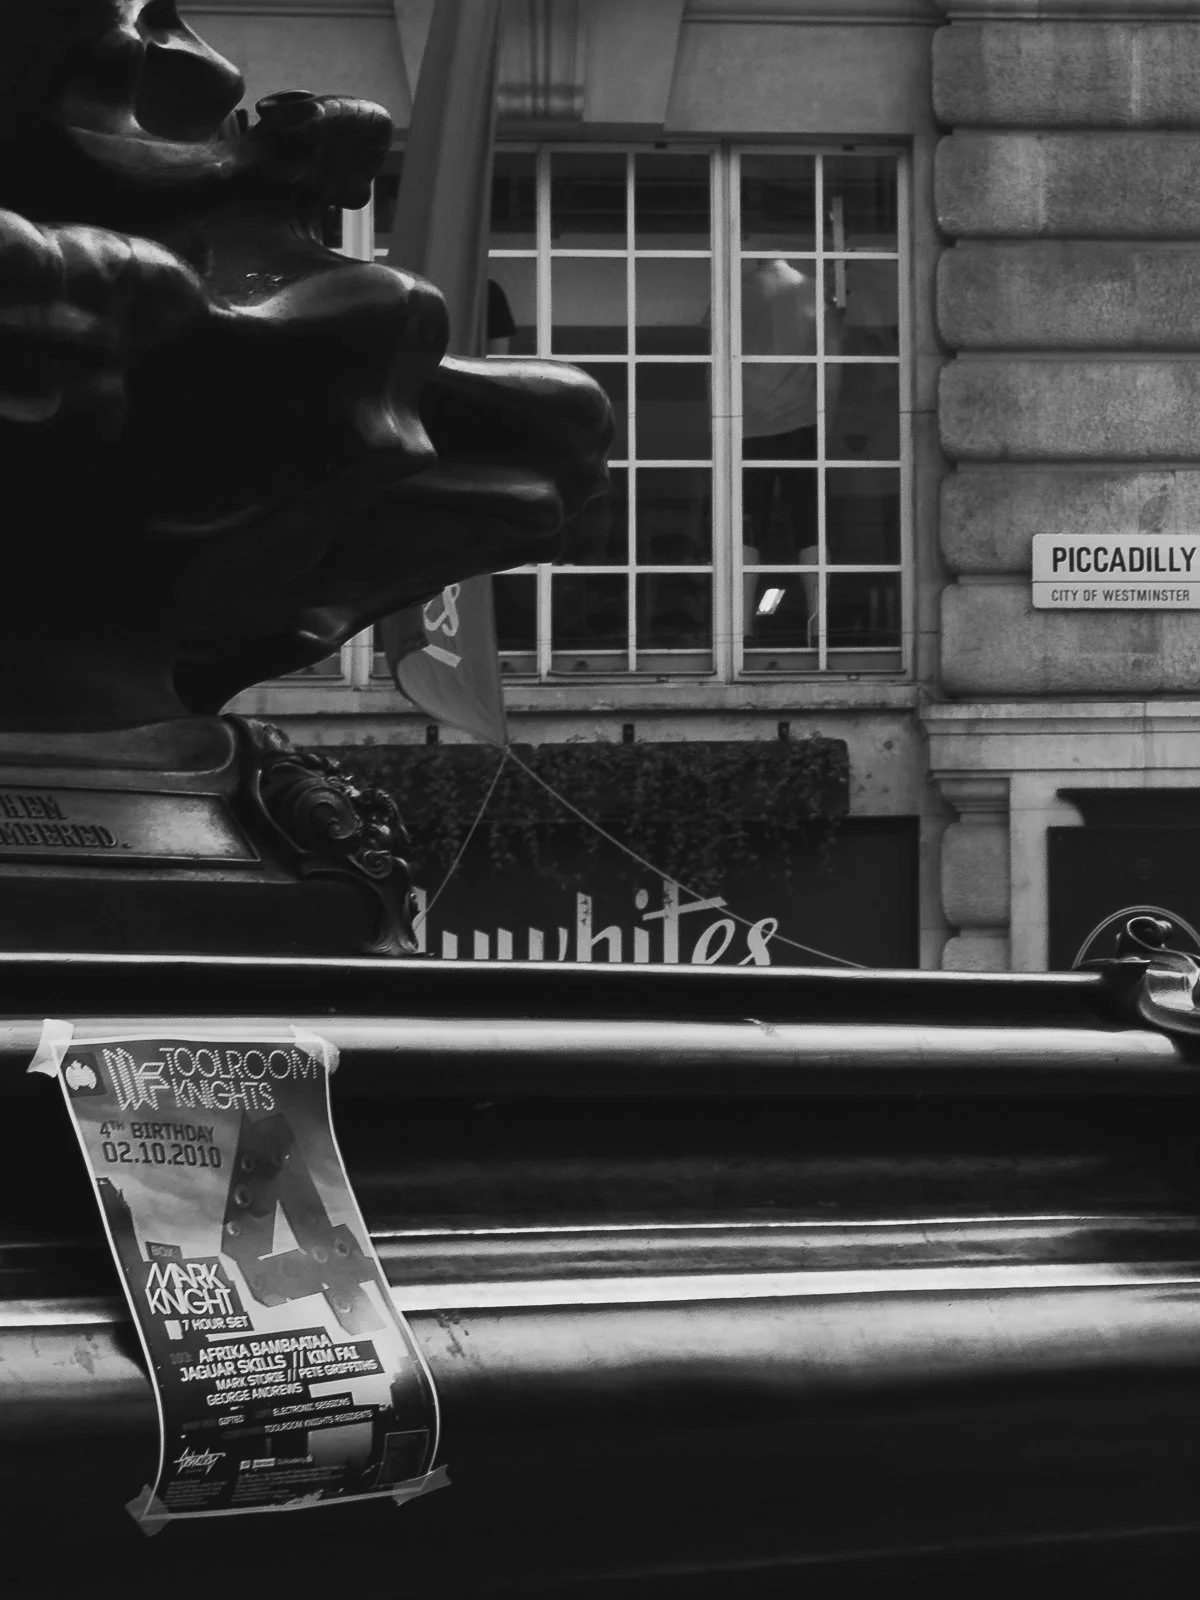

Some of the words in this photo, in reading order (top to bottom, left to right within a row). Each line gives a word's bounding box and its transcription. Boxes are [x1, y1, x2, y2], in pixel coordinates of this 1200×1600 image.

[1052, 546, 1197, 573] PICCADILLY
[1051, 589, 1078, 602] CITY
[1083, 589, 1098, 602] OF
[1103, 589, 1190, 602] WESTMINSTER
[159, 1047, 318, 1079] TOOLROOM
[172, 1078, 276, 1111] KNIGHTS
[130, 1121, 216, 1143] BIRTHDAY
[102, 1141, 222, 1169] 02.10.2010
[146, 1262, 226, 1289] MARK
[145, 1288, 234, 1315] KNIGHT
[181, 1319, 190, 1331] 7
[191, 1317, 226, 1331] HOUR
[225, 1315, 249, 1330] SET
[199, 1343, 251, 1364] AFRIKA
[250, 1334, 333, 1356] BAMBAATAA
[180, 1361, 237, 1382] JAGUAR
[237, 1355, 287, 1373] SKILLS
[307, 1349, 335, 1365] KIM
[335, 1346, 361, 1361] FAI
[216, 1376, 248, 1391] MARK
[248, 1371, 286, 1388] STORIE
[299, 1366, 325, 1379] PETE
[324, 1359, 379, 1376] GRIFFITHS
[206, 1389, 251, 1406] GEORGE
[252, 1383, 304, 1400] ANDREWS
